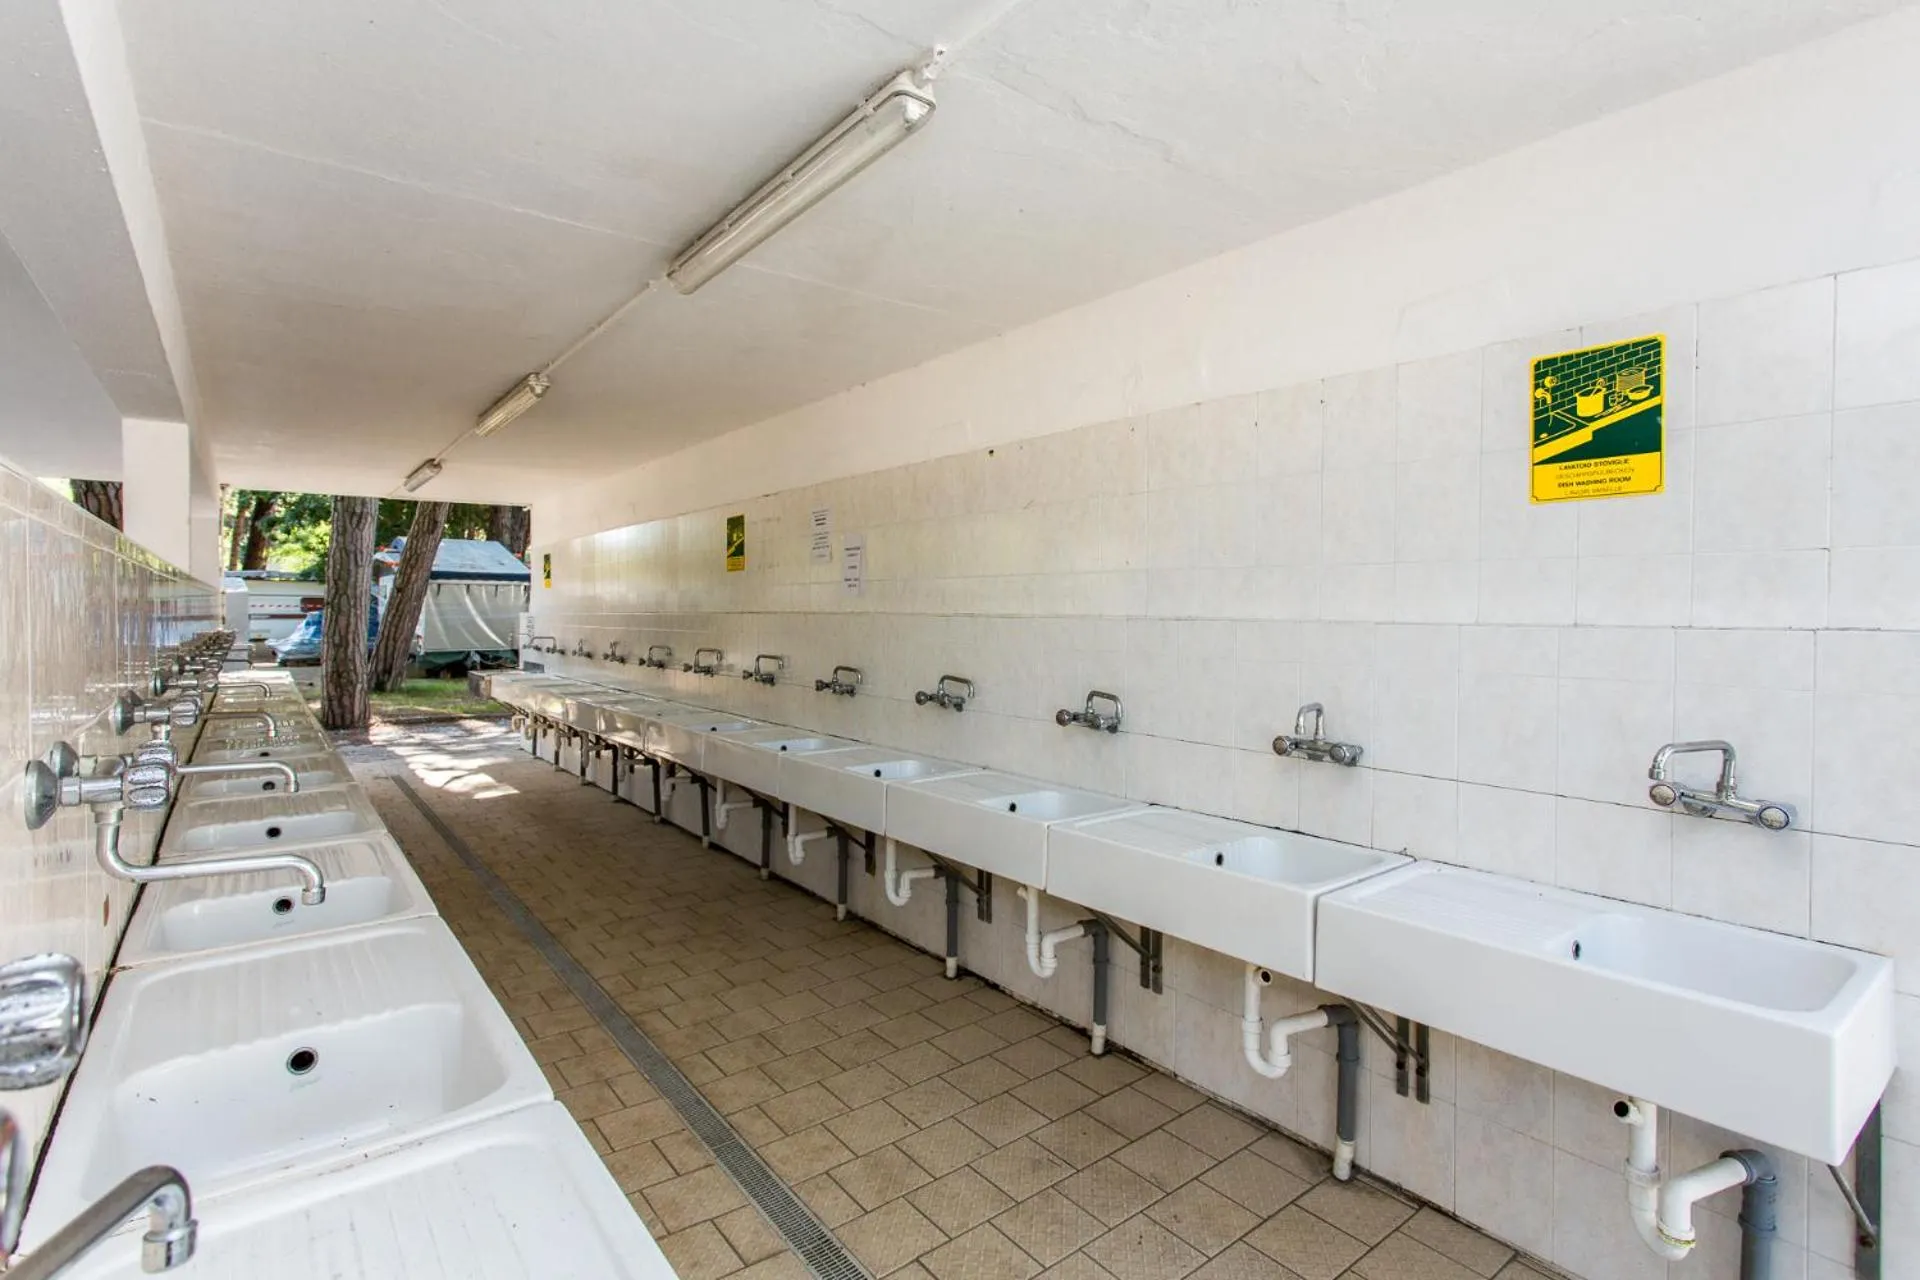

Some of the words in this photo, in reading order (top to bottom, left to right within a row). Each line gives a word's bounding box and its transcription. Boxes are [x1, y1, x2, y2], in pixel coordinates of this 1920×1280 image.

[1558, 480, 1574, 489] DISH
[1575, 478, 1607, 487] WASHING
[1608, 476, 1632, 484] ROOM
